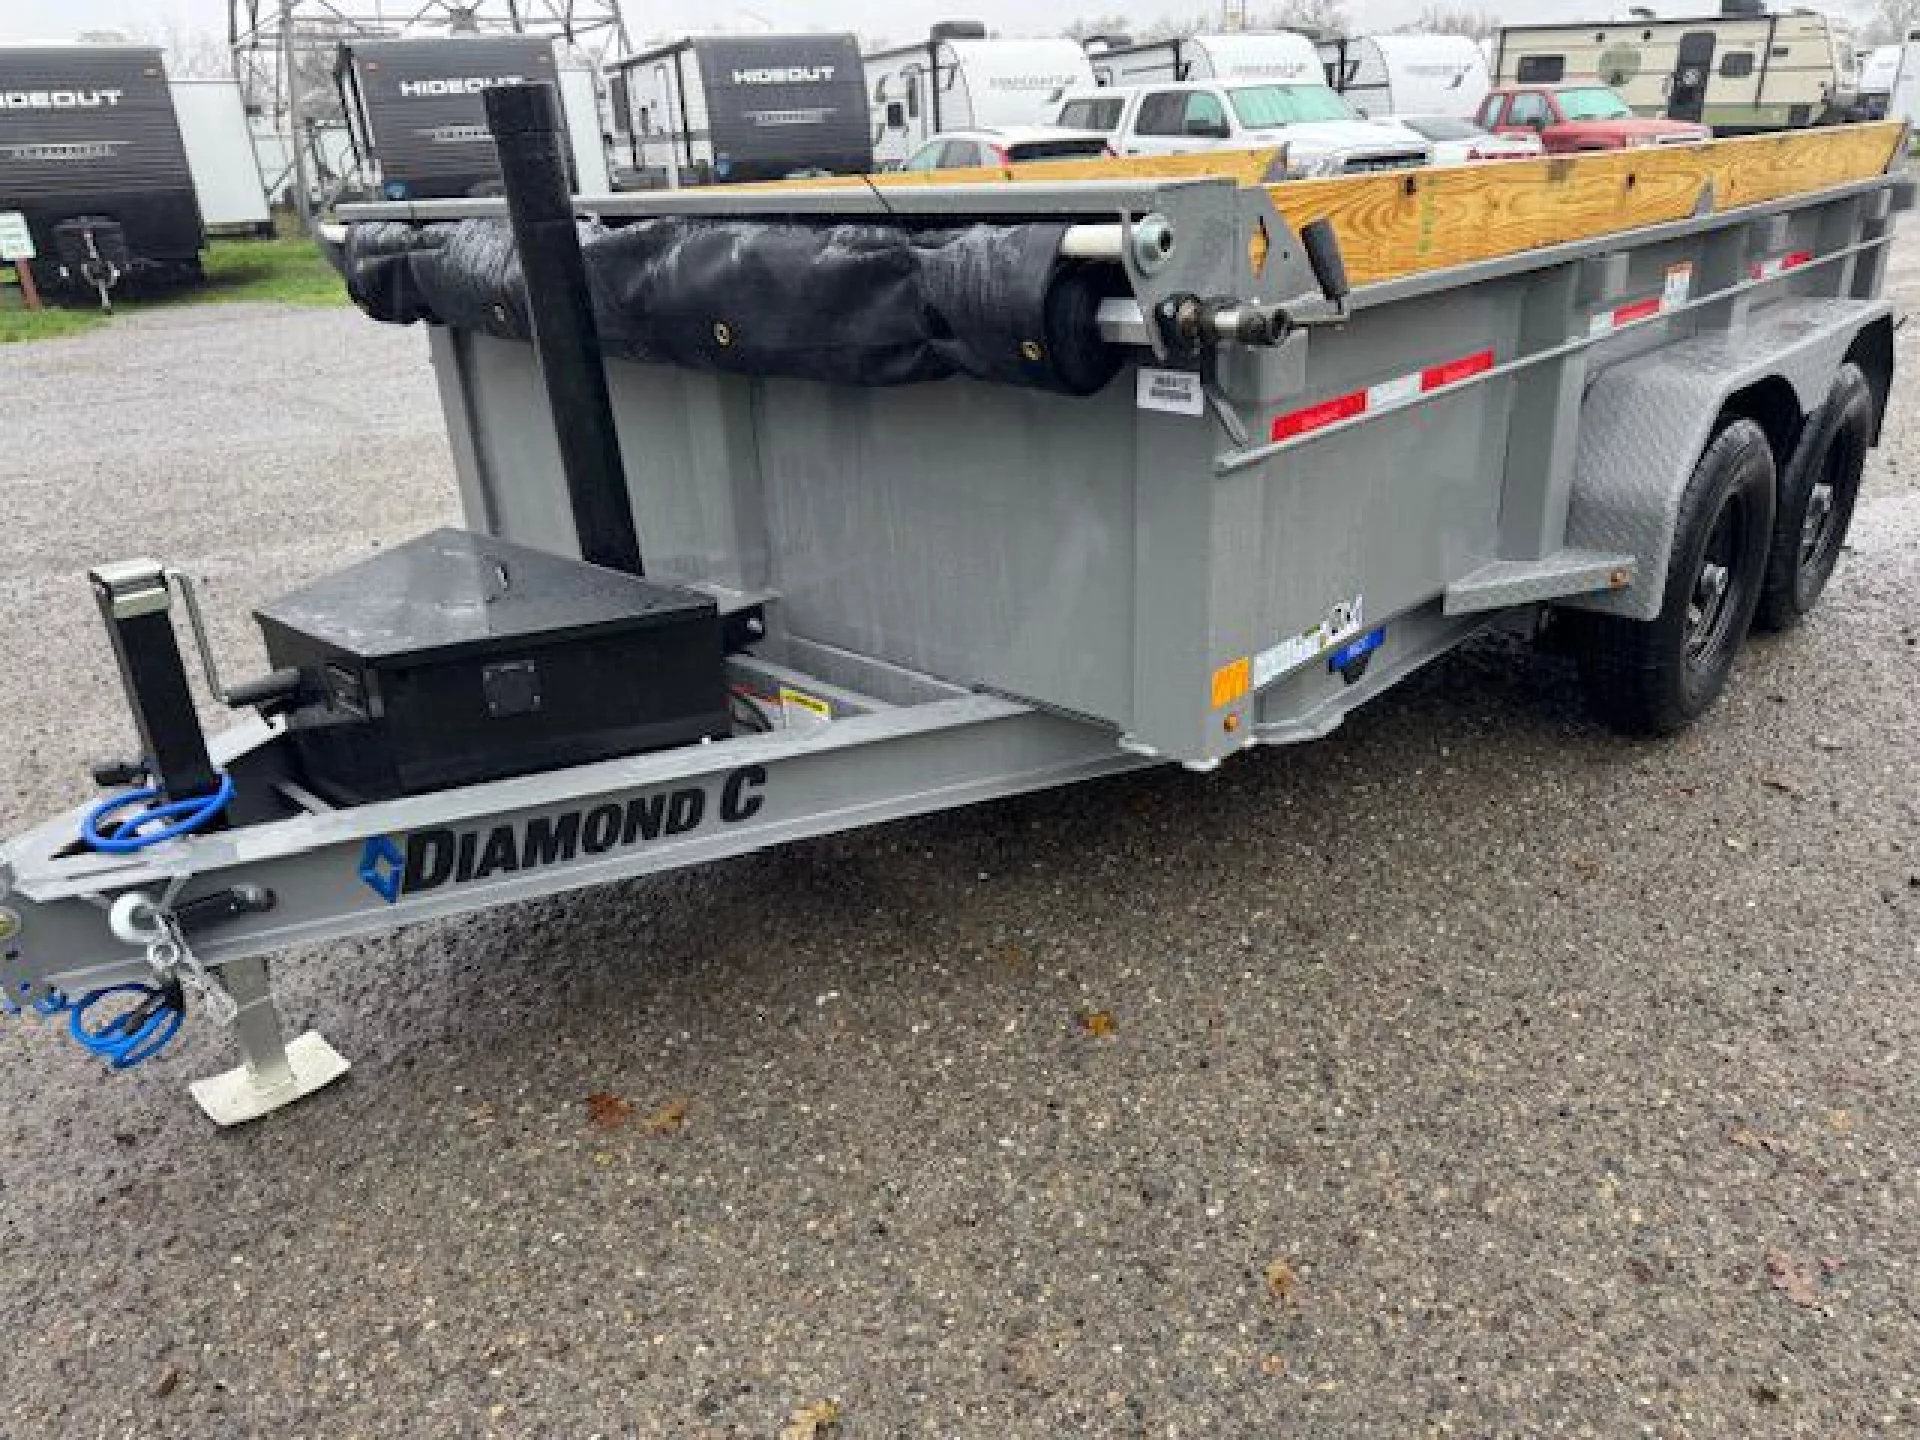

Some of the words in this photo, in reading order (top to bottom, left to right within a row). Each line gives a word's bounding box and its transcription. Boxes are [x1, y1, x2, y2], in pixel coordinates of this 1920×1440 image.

[732, 67, 834, 84] HIDEOUT
[0, 88, 122, 108] IDEOUT
[402, 787, 706, 895] DIAMOND
[721, 764, 766, 822] C
